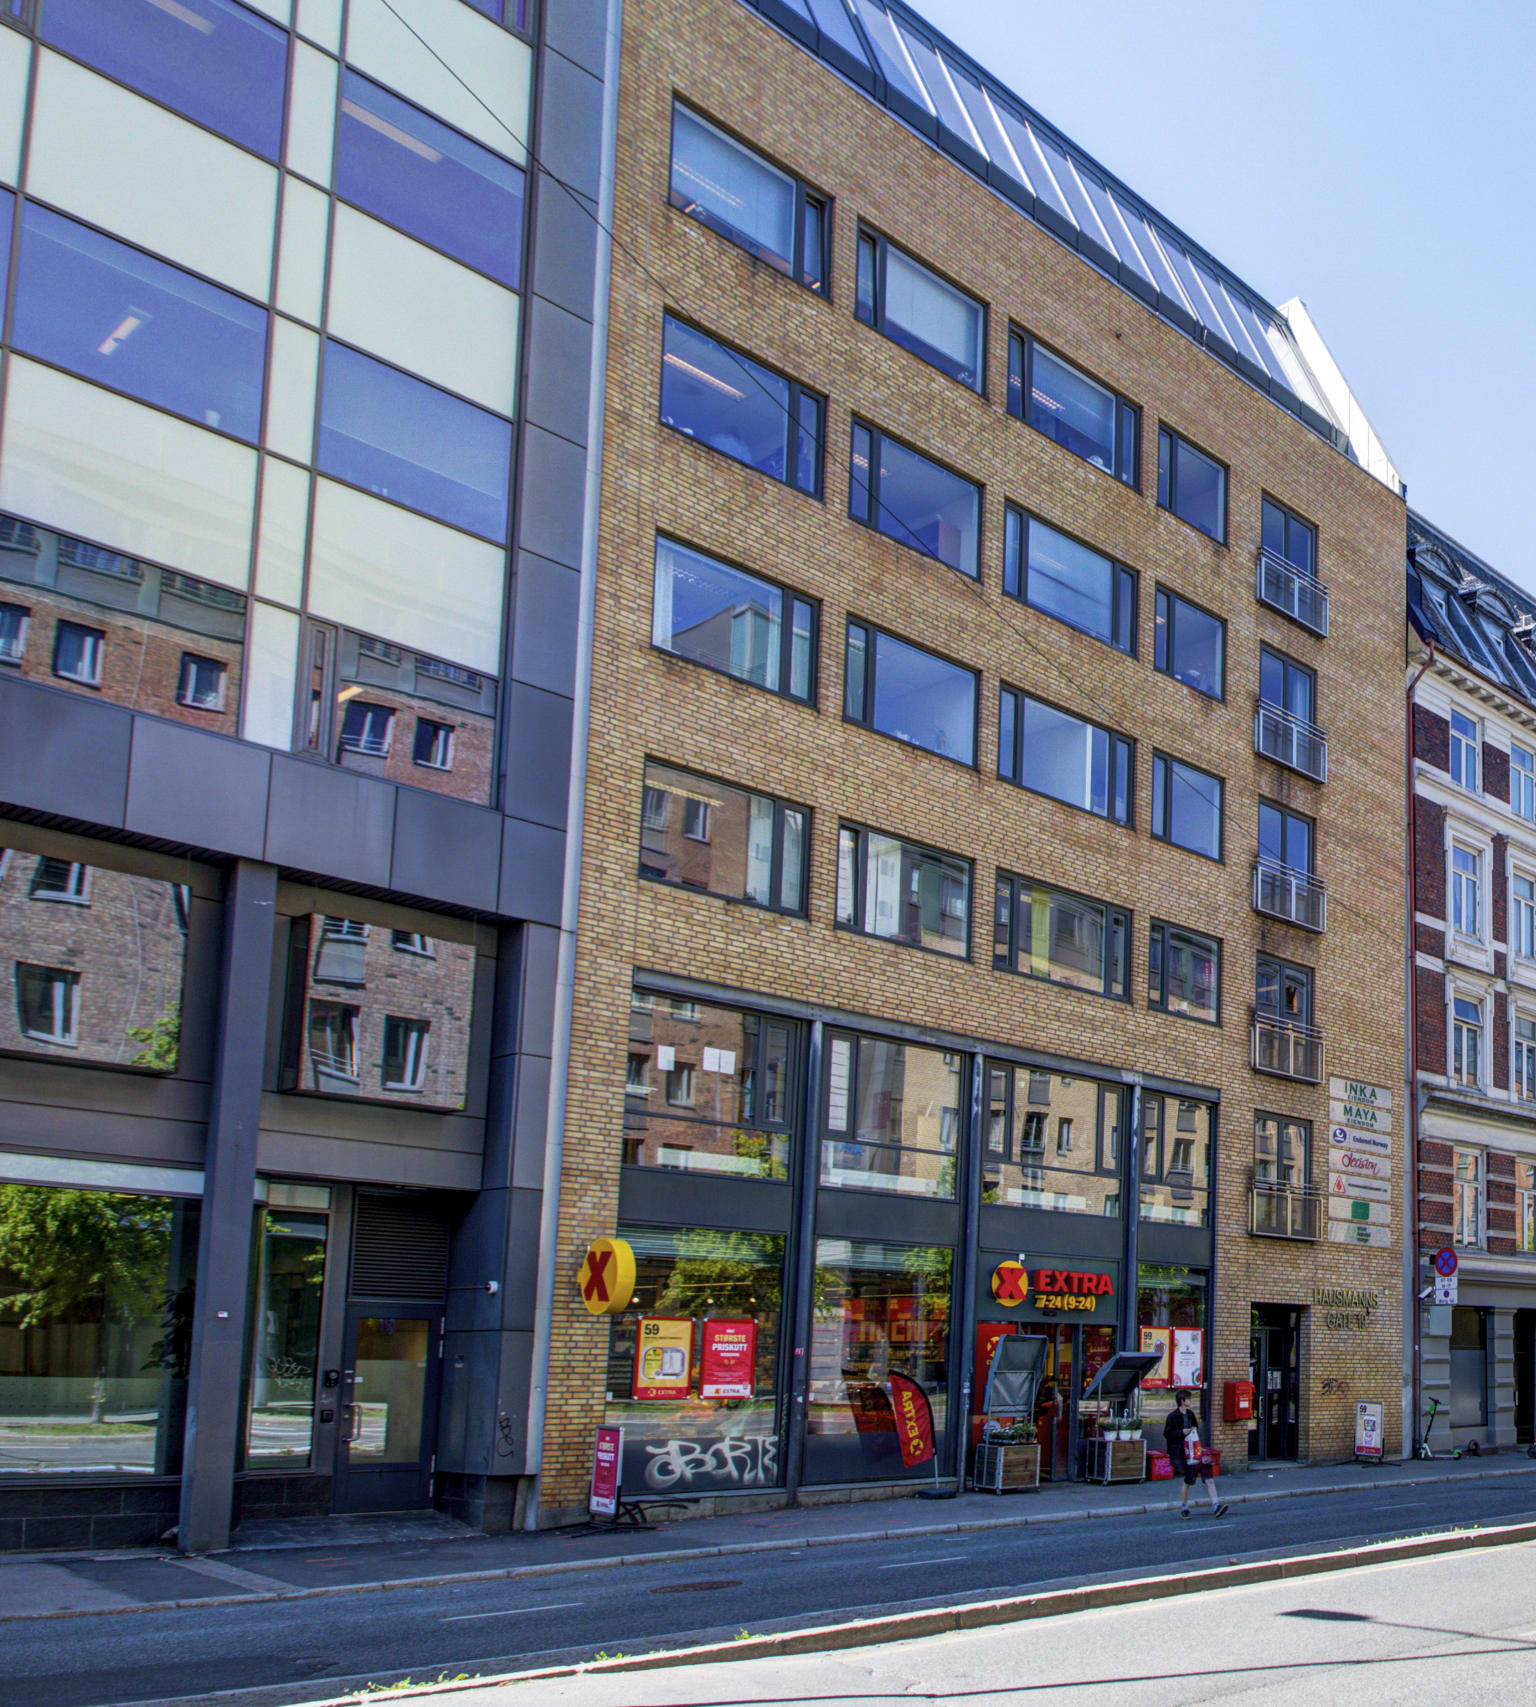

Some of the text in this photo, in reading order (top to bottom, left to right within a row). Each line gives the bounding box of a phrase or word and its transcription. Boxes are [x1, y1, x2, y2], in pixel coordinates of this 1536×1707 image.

[1344, 1081, 1377, 1100] INKA
[1344, 1104, 1377, 1123] MAYA
[584, 1251, 613, 1302] X
[1033, 1269, 1114, 1296] EXTRA
[1063, 1294, 1096, 1312] (9-24)
[1312, 1287, 1379, 1309] HAUSMANNS
[644, 1323, 660, 1336] 59
[1327, 1311, 1353, 1329] GATE
